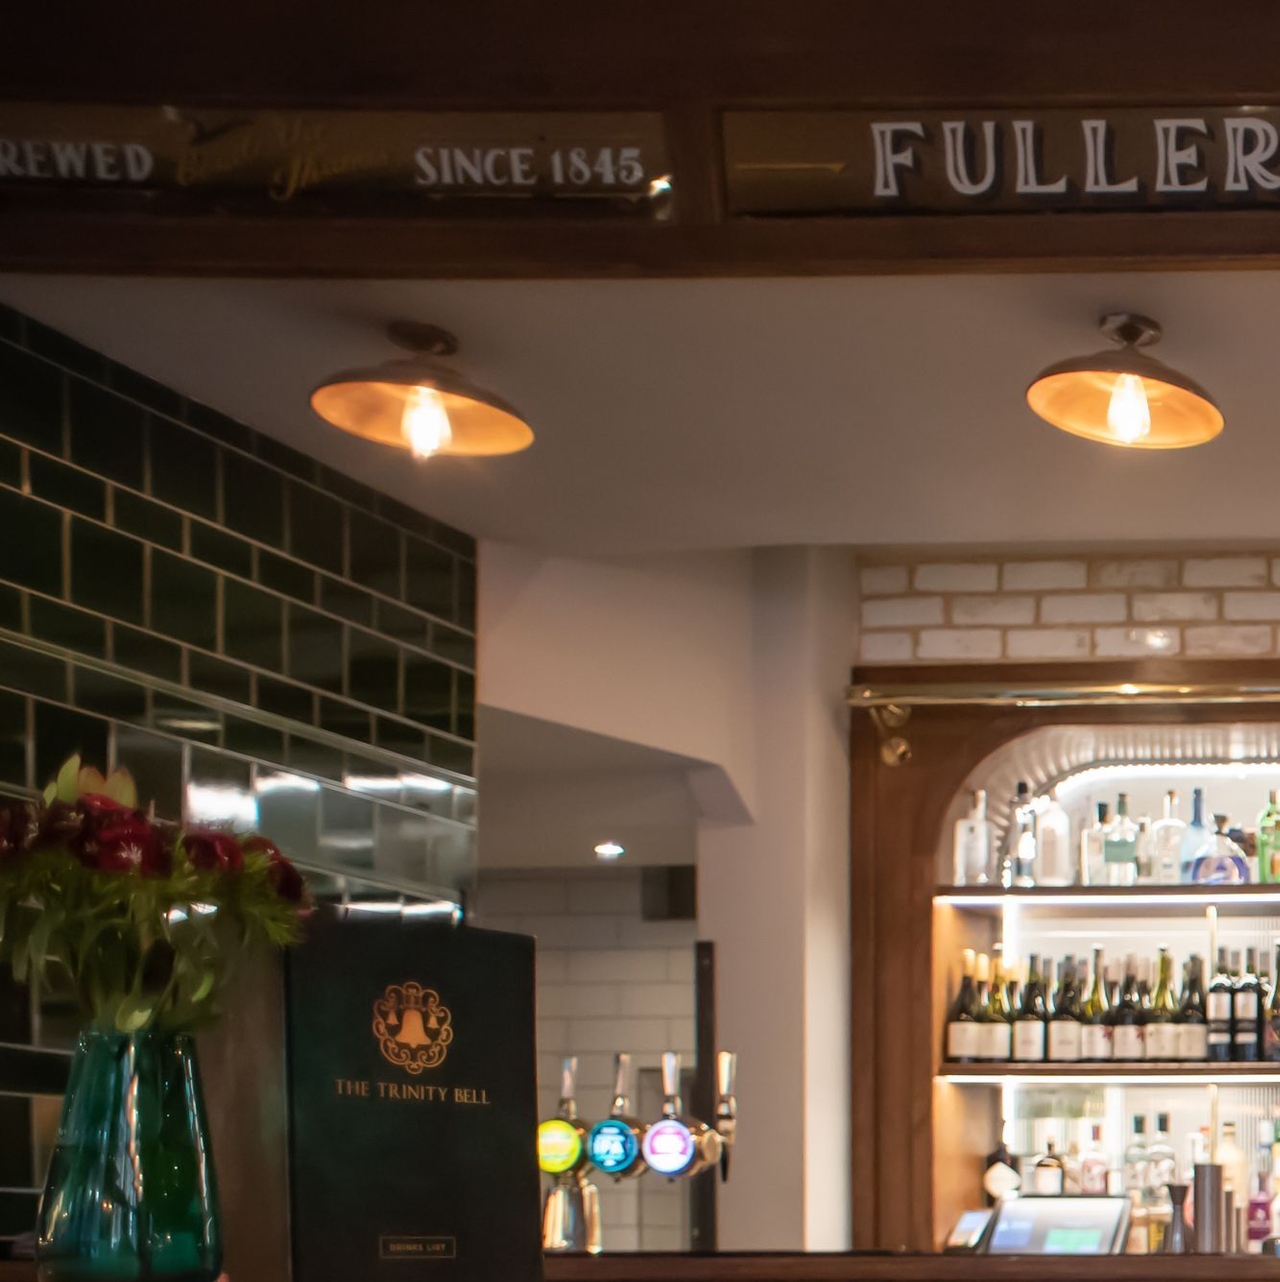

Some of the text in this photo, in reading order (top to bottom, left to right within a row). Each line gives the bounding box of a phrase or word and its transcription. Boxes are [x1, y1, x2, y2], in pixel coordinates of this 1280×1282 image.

[414, 146, 536, 186] SINCE
[550, 146, 645, 187] 1845
[335, 1078, 491, 1105] THE TRINITY BELL
